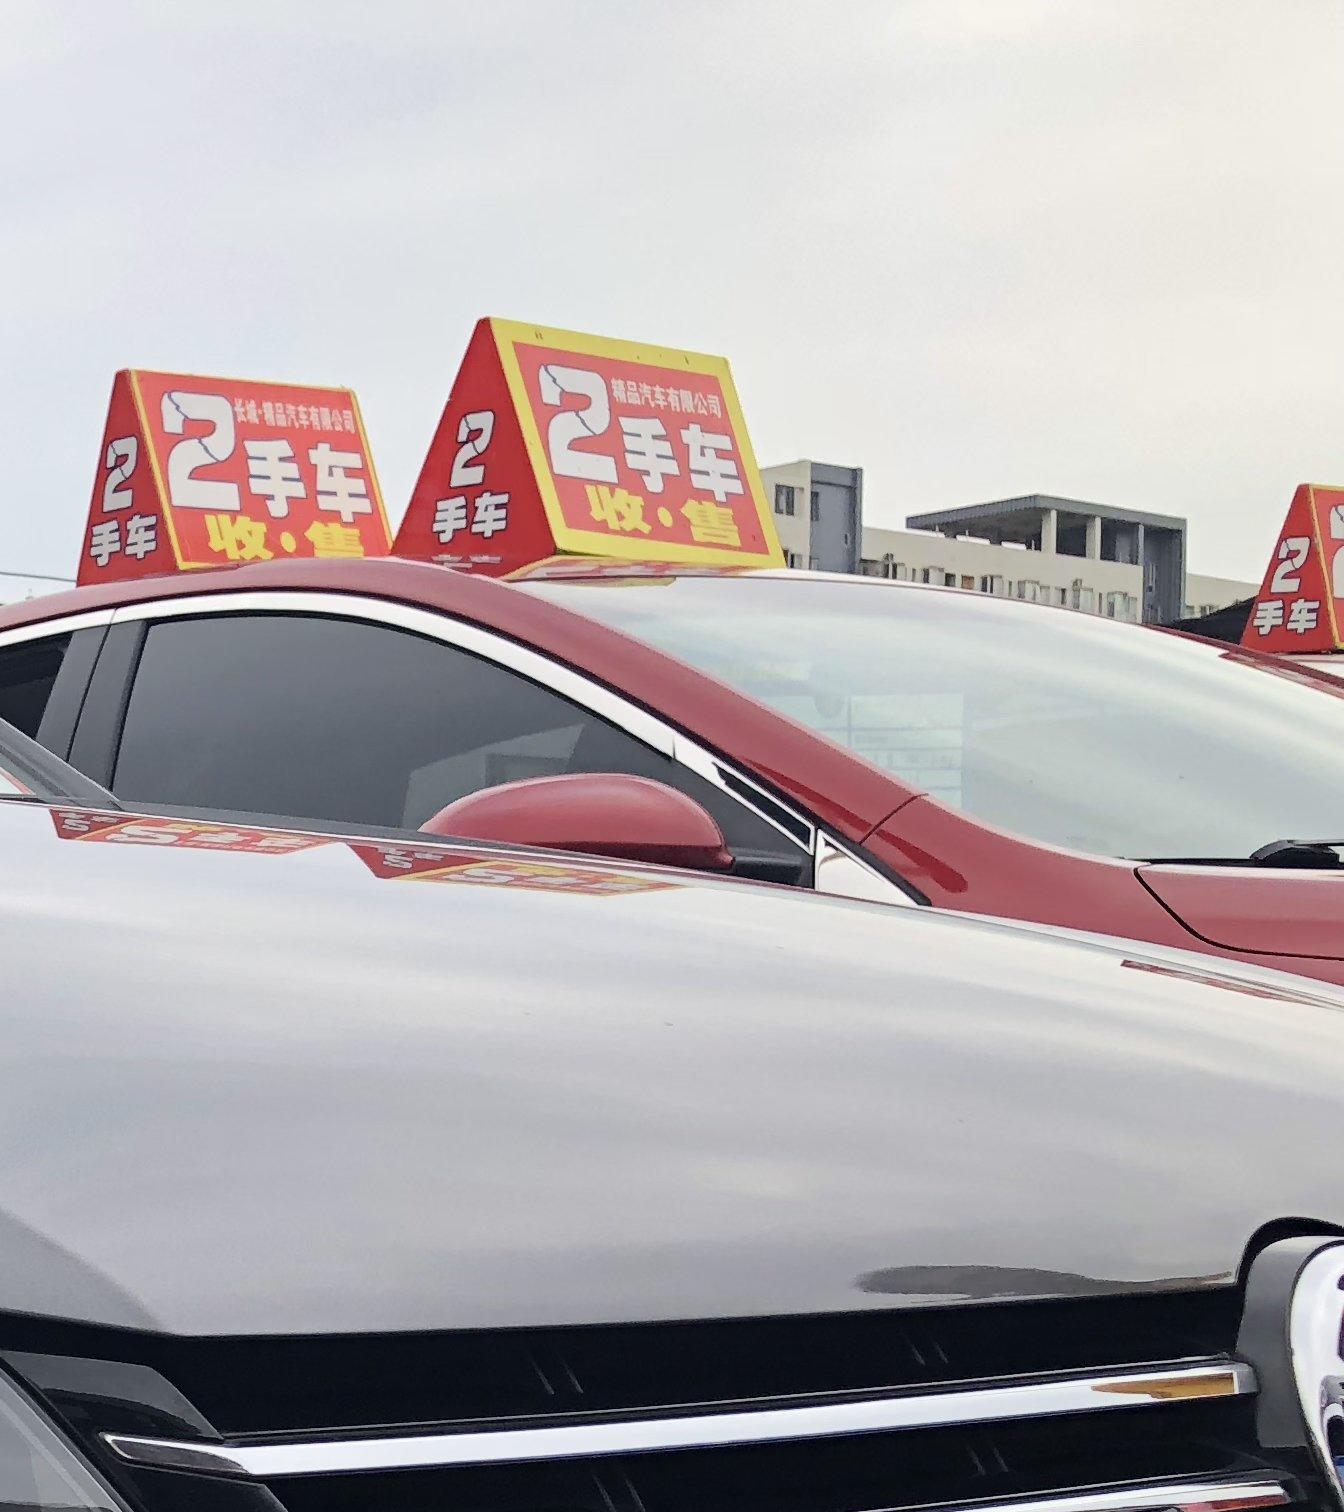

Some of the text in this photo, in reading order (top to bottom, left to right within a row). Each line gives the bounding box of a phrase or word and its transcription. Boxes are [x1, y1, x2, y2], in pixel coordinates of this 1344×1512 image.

[611, 377, 722, 418] 精品汽车有限公司
[161, 390, 373, 523] 2手车
[449, 409, 495, 488] 2
[538, 363, 745, 503] 2手车
[102, 436, 138, 512] 2
[90, 514, 157, 567] 手车
[432, 491, 510, 544] 手车
[1270, 536, 1311, 594] 2
[1252, 598, 1320, 636] 手车
